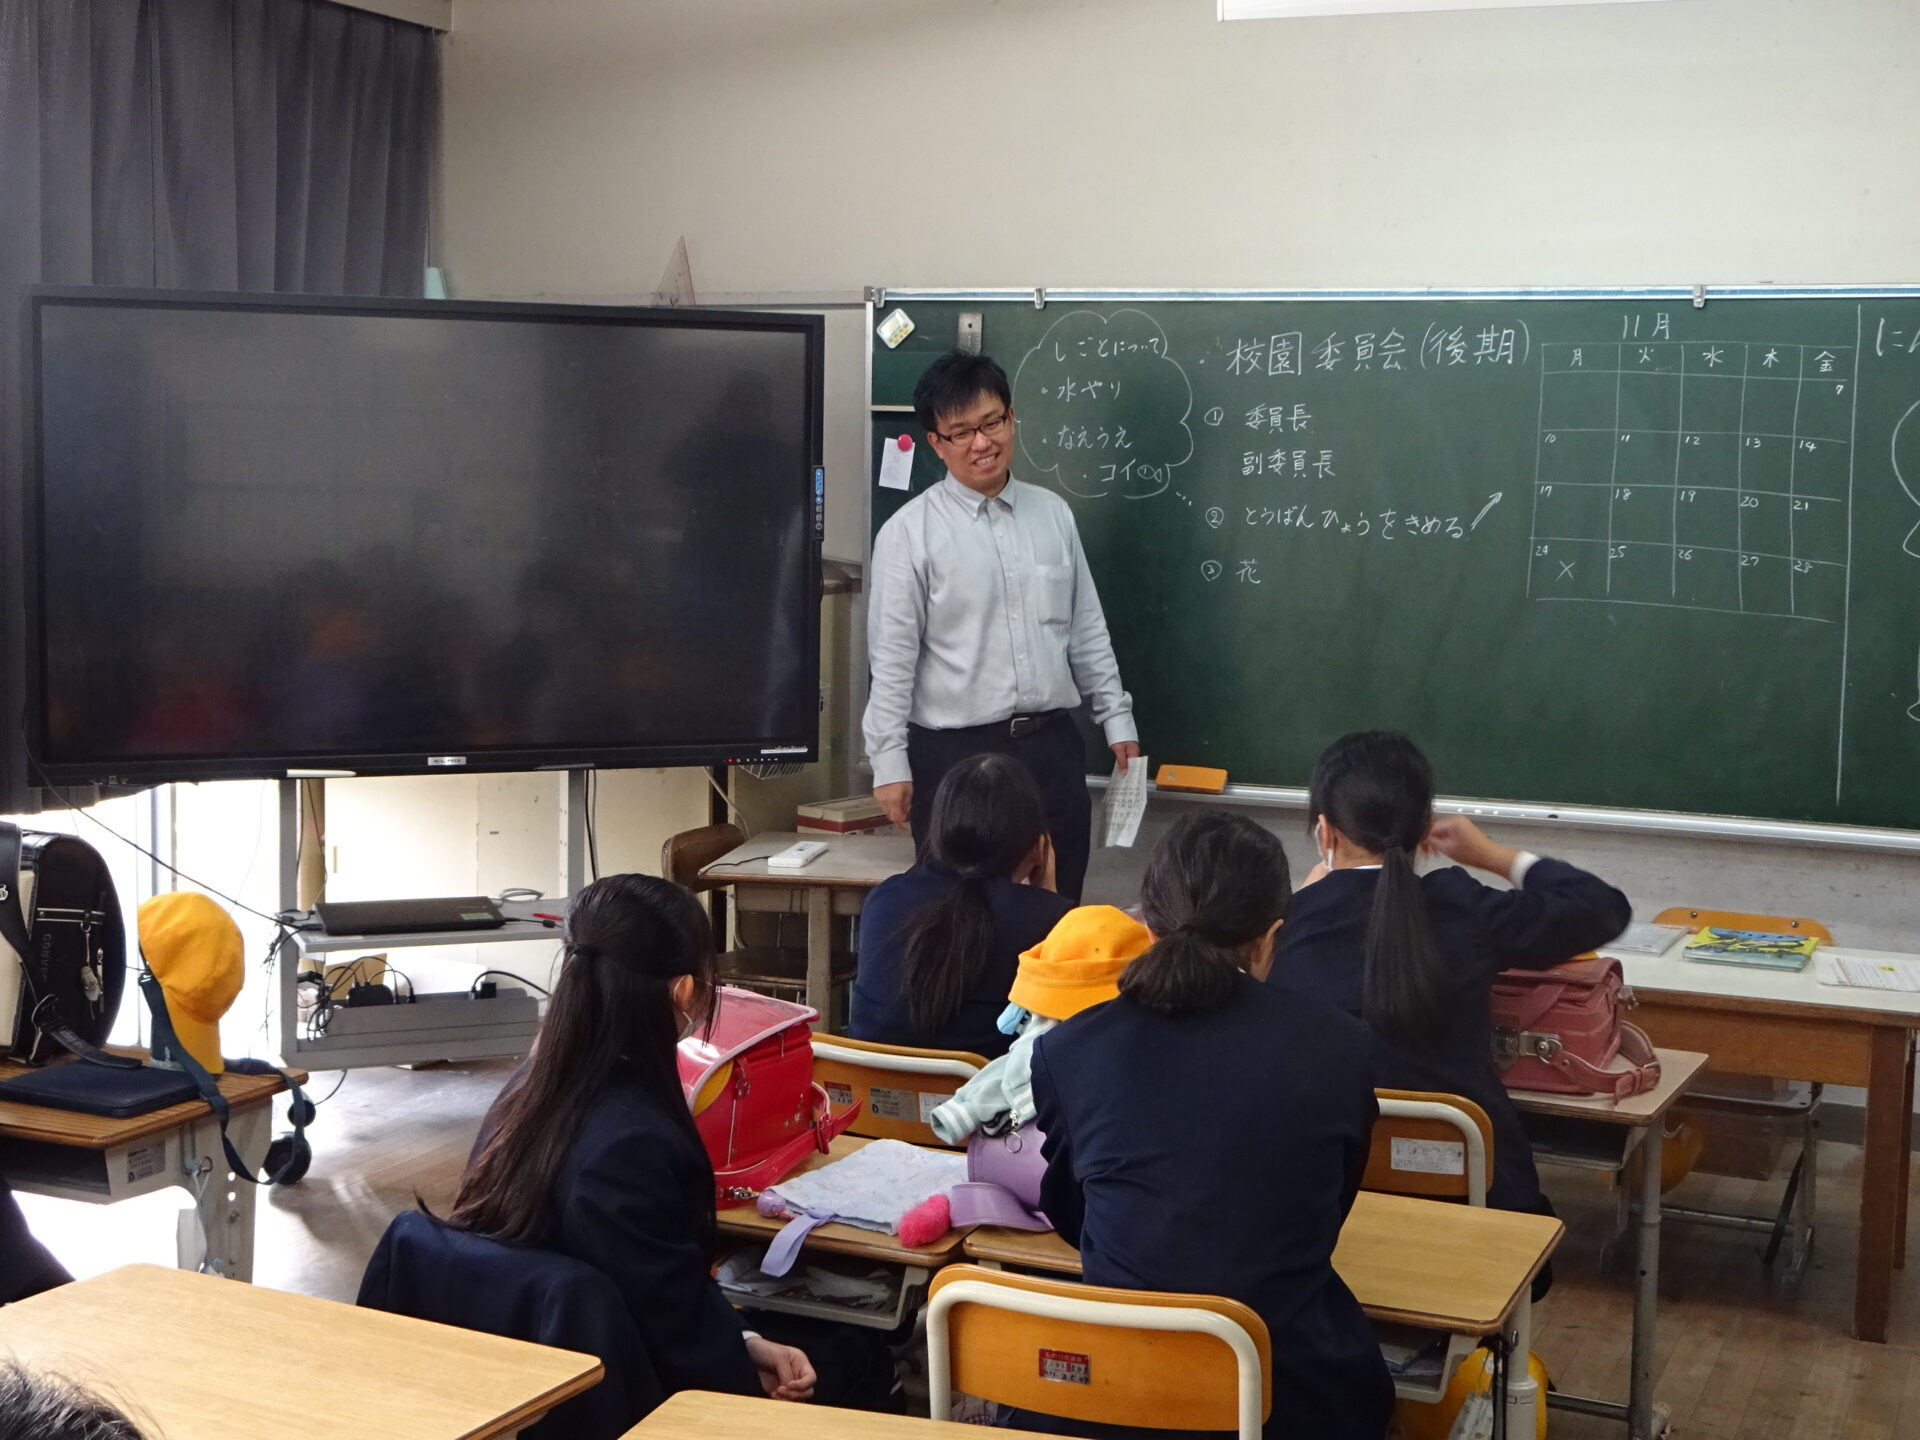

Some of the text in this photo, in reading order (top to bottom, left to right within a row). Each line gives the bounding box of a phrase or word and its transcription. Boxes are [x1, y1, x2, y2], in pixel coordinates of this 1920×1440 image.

[1622, 312, 1670, 339] 11月
[1055, 336, 1160, 362] しごとについて
[1570, 345, 1836, 373] 月 火 水 木 金
[1835, 384, 1845, 396] 7
[1244, 403, 1312, 435] 委員長
[1544, 433, 1817, 453] 10 11 12 13 14
[1241, 448, 1336, 479] 副委員長
[1539, 485, 1809, 511] 17 18 19 20 21
[1235, 558, 1261, 585] 花
[1609, 545, 1628, 560] 25
[1678, 549, 1694, 561] 26
[1739, 554, 1760, 569] 27
[1793, 559, 1814, 574] 28
